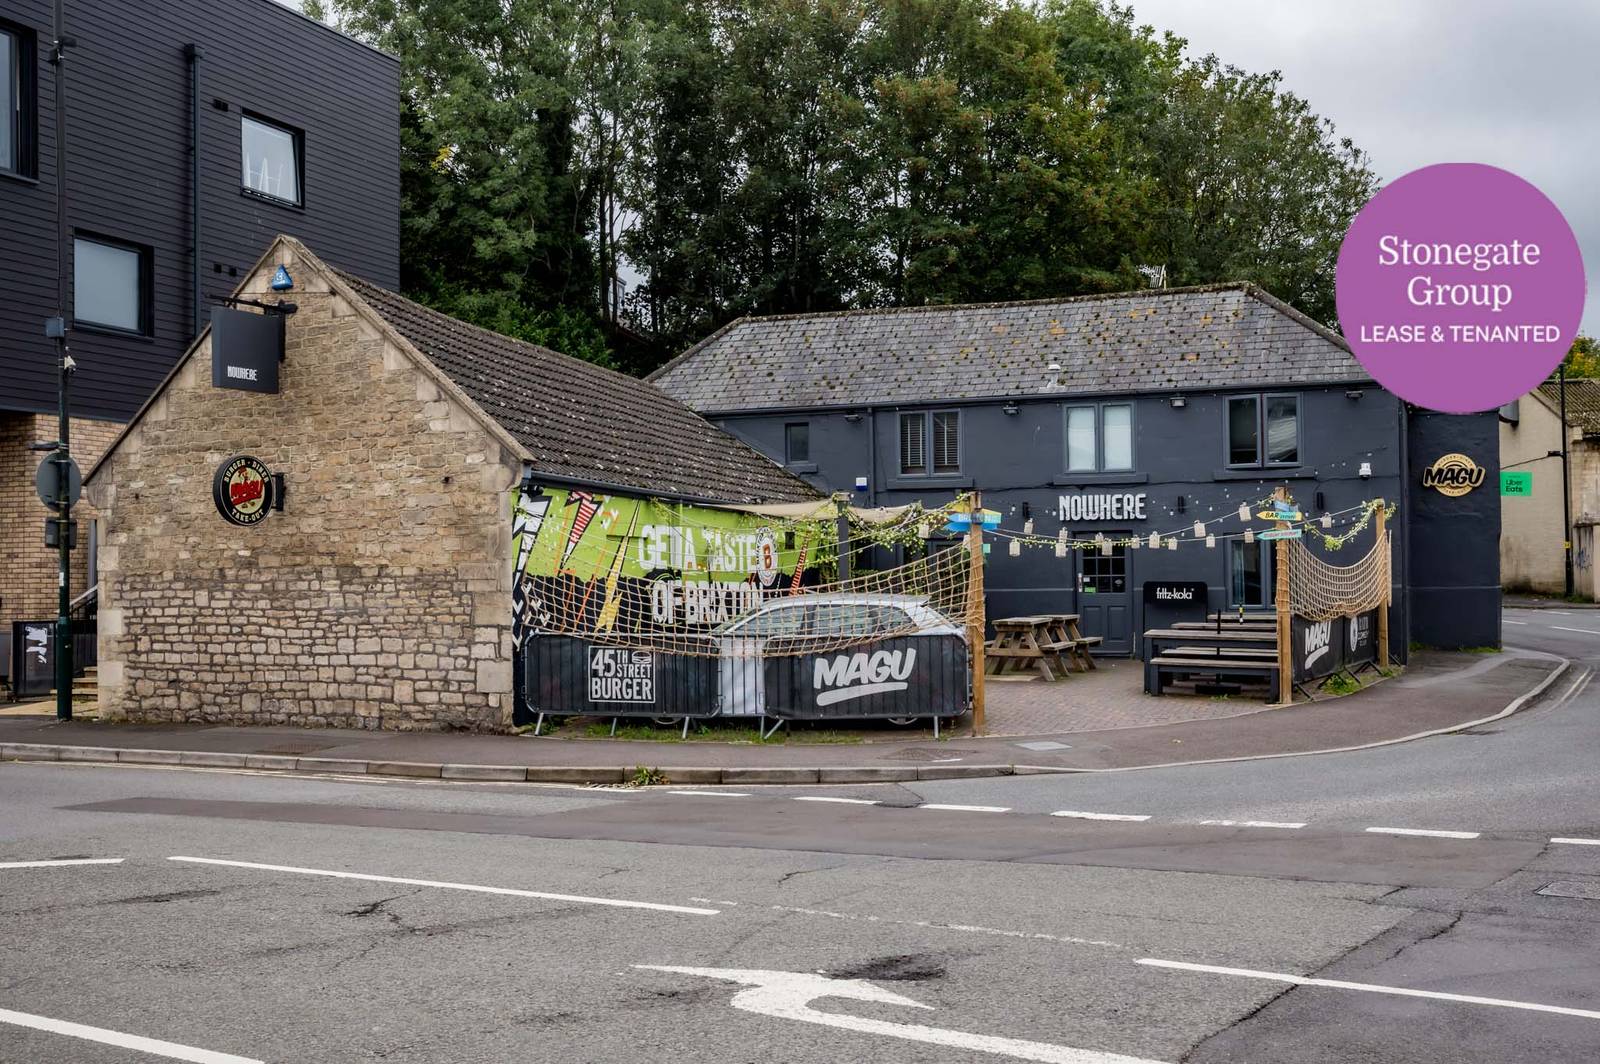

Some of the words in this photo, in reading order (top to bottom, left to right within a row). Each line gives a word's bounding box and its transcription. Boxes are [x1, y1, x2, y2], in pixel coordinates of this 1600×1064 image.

[227, 365, 258, 381] NOWHERE
[224, 459, 246, 482] BURGER
[1423, 467, 1484, 486] MAGU
[232, 508, 264, 522] TAKE-OUT
[1059, 493, 1147, 521] NOWHERE
[638, 524, 682, 570] GET
[683, 527, 698, 571] A
[701, 528, 757, 573] TASTE
[652, 580, 683, 624] OF
[1156, 587, 1193, 600] fritz-kola
[1305, 618, 1332, 655] MAGU
[592, 649, 628, 677] 45TH
[616, 664, 652, 678] STREET
[813, 648, 917, 690] MAGU
[592, 678, 652, 700] BURGER
